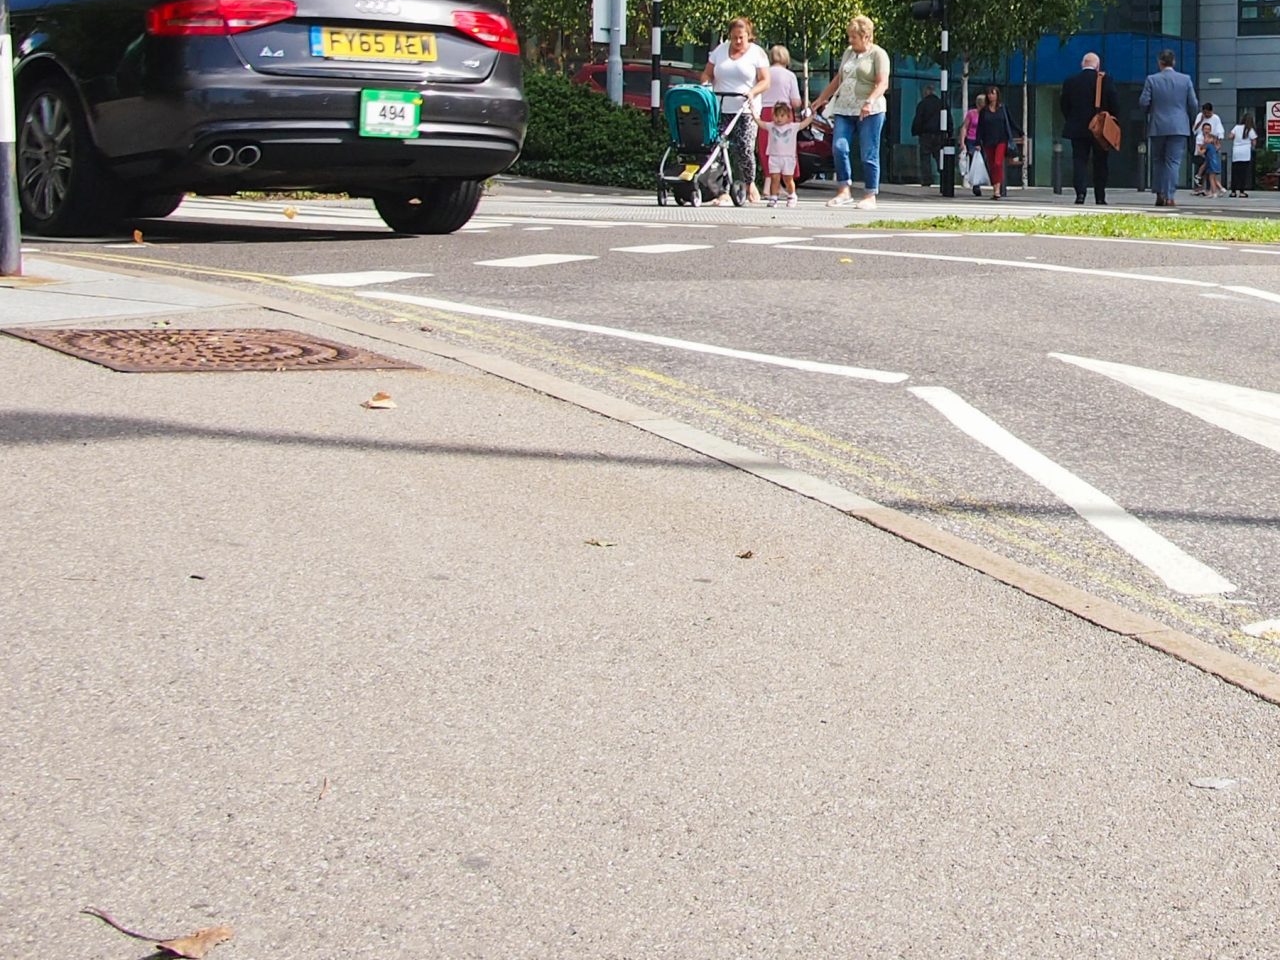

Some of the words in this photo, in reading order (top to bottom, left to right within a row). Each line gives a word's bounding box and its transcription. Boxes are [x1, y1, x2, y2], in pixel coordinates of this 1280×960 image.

[259, 45, 285, 57] A4
[329, 31, 385, 53] FY65
[394, 34, 431, 55] AEW
[378, 104, 407, 121] 494
